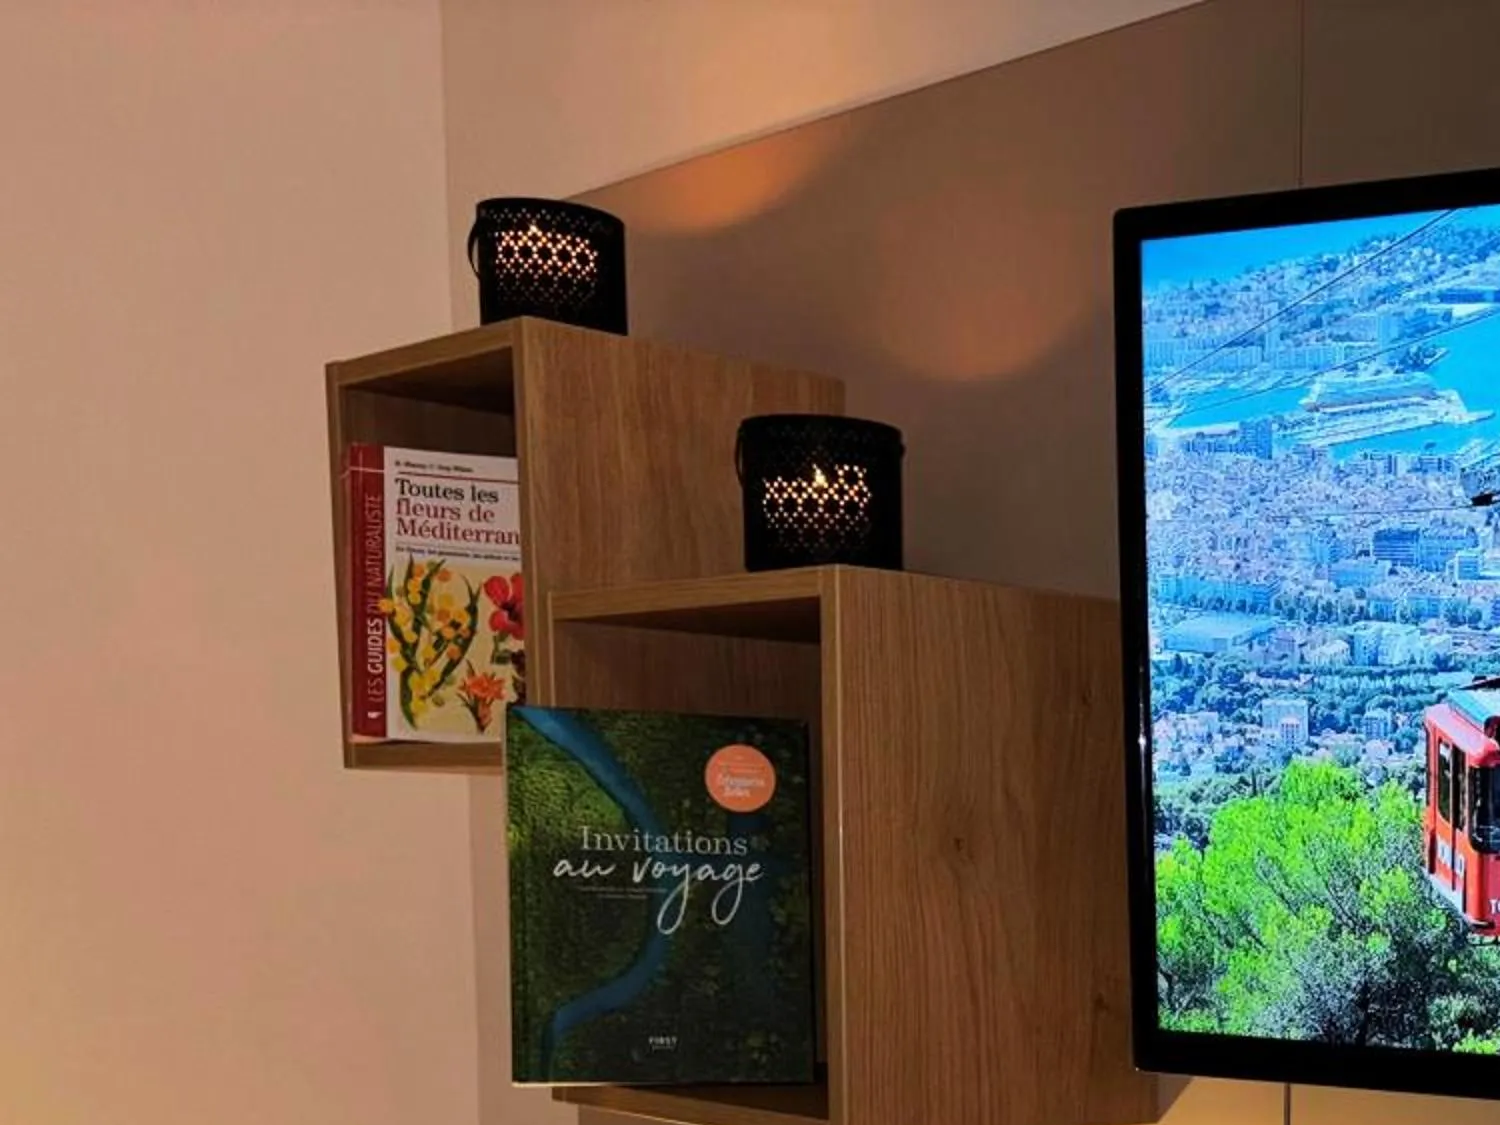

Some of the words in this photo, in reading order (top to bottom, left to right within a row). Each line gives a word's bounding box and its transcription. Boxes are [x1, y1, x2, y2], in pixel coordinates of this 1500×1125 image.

[395, 478, 464, 501] Toutes
[471, 484, 499, 503] les
[396, 498, 461, 520] fleurs
[468, 504, 495, 522] de
[365, 494, 383, 588] NATURALISTE
[367, 617, 384, 674] GUIDES
[368, 674, 384, 704] LES
[580, 825, 748, 856] Invitations
[553, 859, 616, 877] au
[632, 856, 764, 935] voyage
